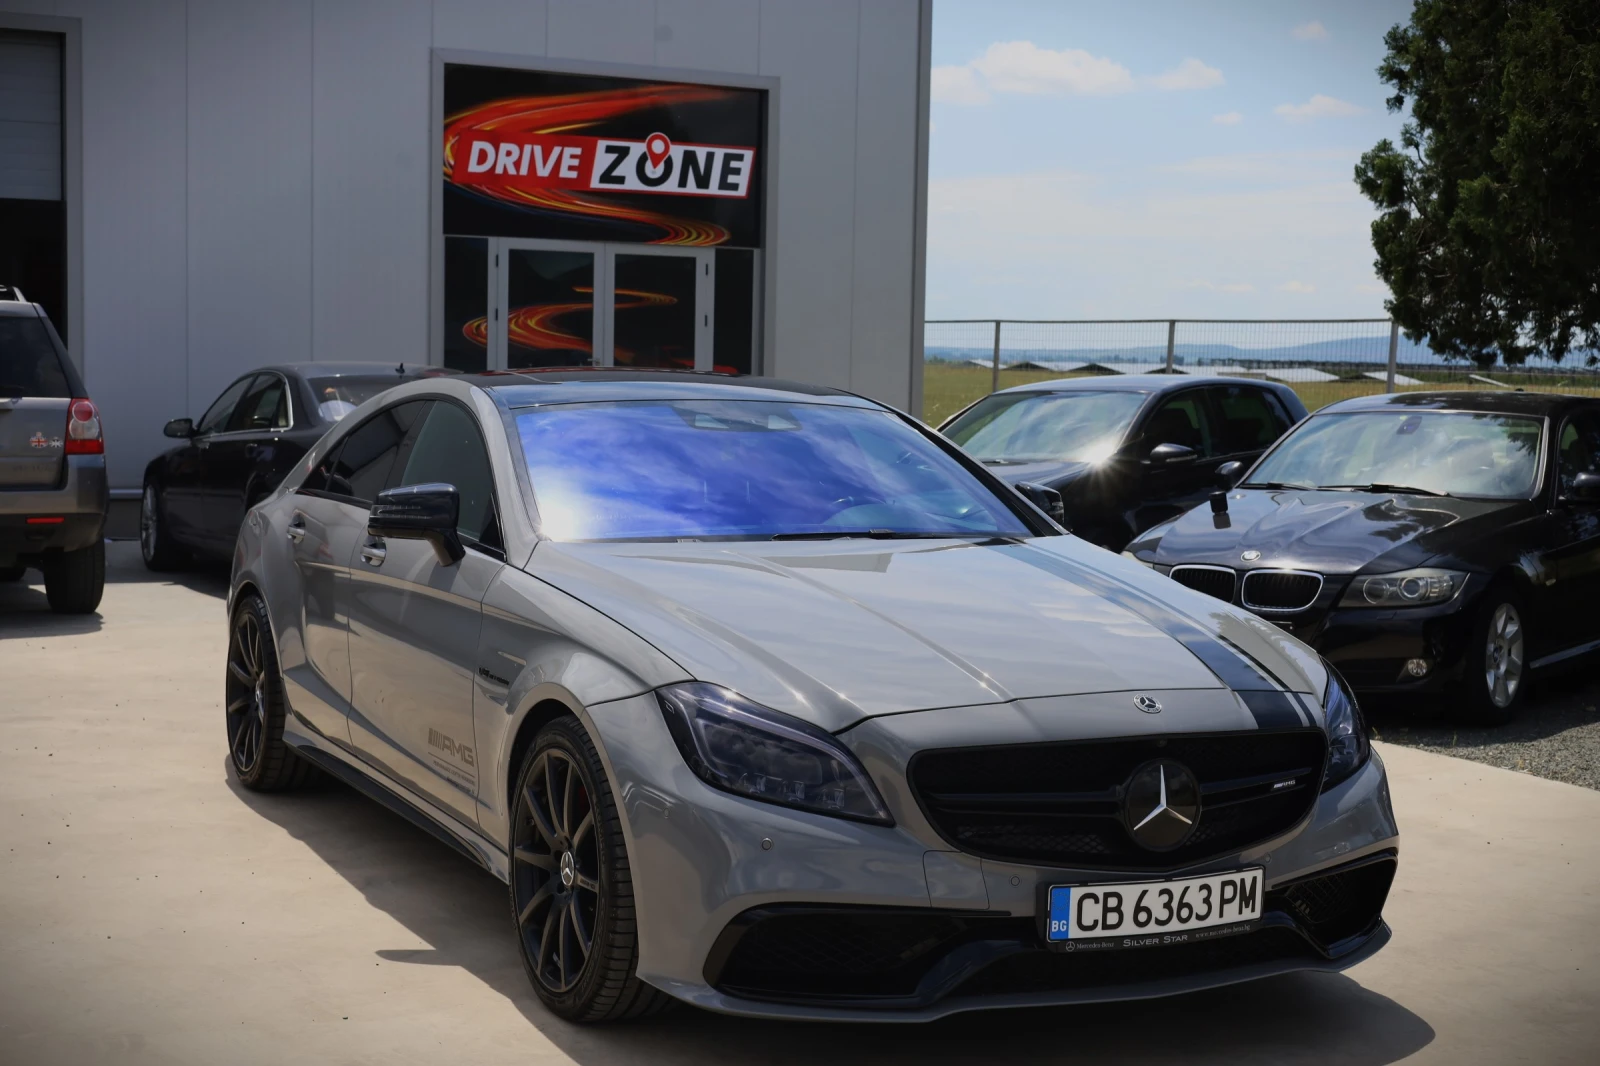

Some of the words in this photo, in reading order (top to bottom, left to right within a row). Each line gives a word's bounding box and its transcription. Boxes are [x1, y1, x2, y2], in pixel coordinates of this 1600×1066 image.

[467, 140, 582, 179] DRIVE
[598, 145, 745, 192] ZONE
[440, 733, 475, 767] AMG
[1076, 891, 1124, 931] CB
[1132, 884, 1213, 928] 6363
[1218, 876, 1257, 919] PM
[1051, 920, 1067, 933] BG
[1123, 937, 1160, 947] SILVER
[1163, 934, 1188, 944] STAR
